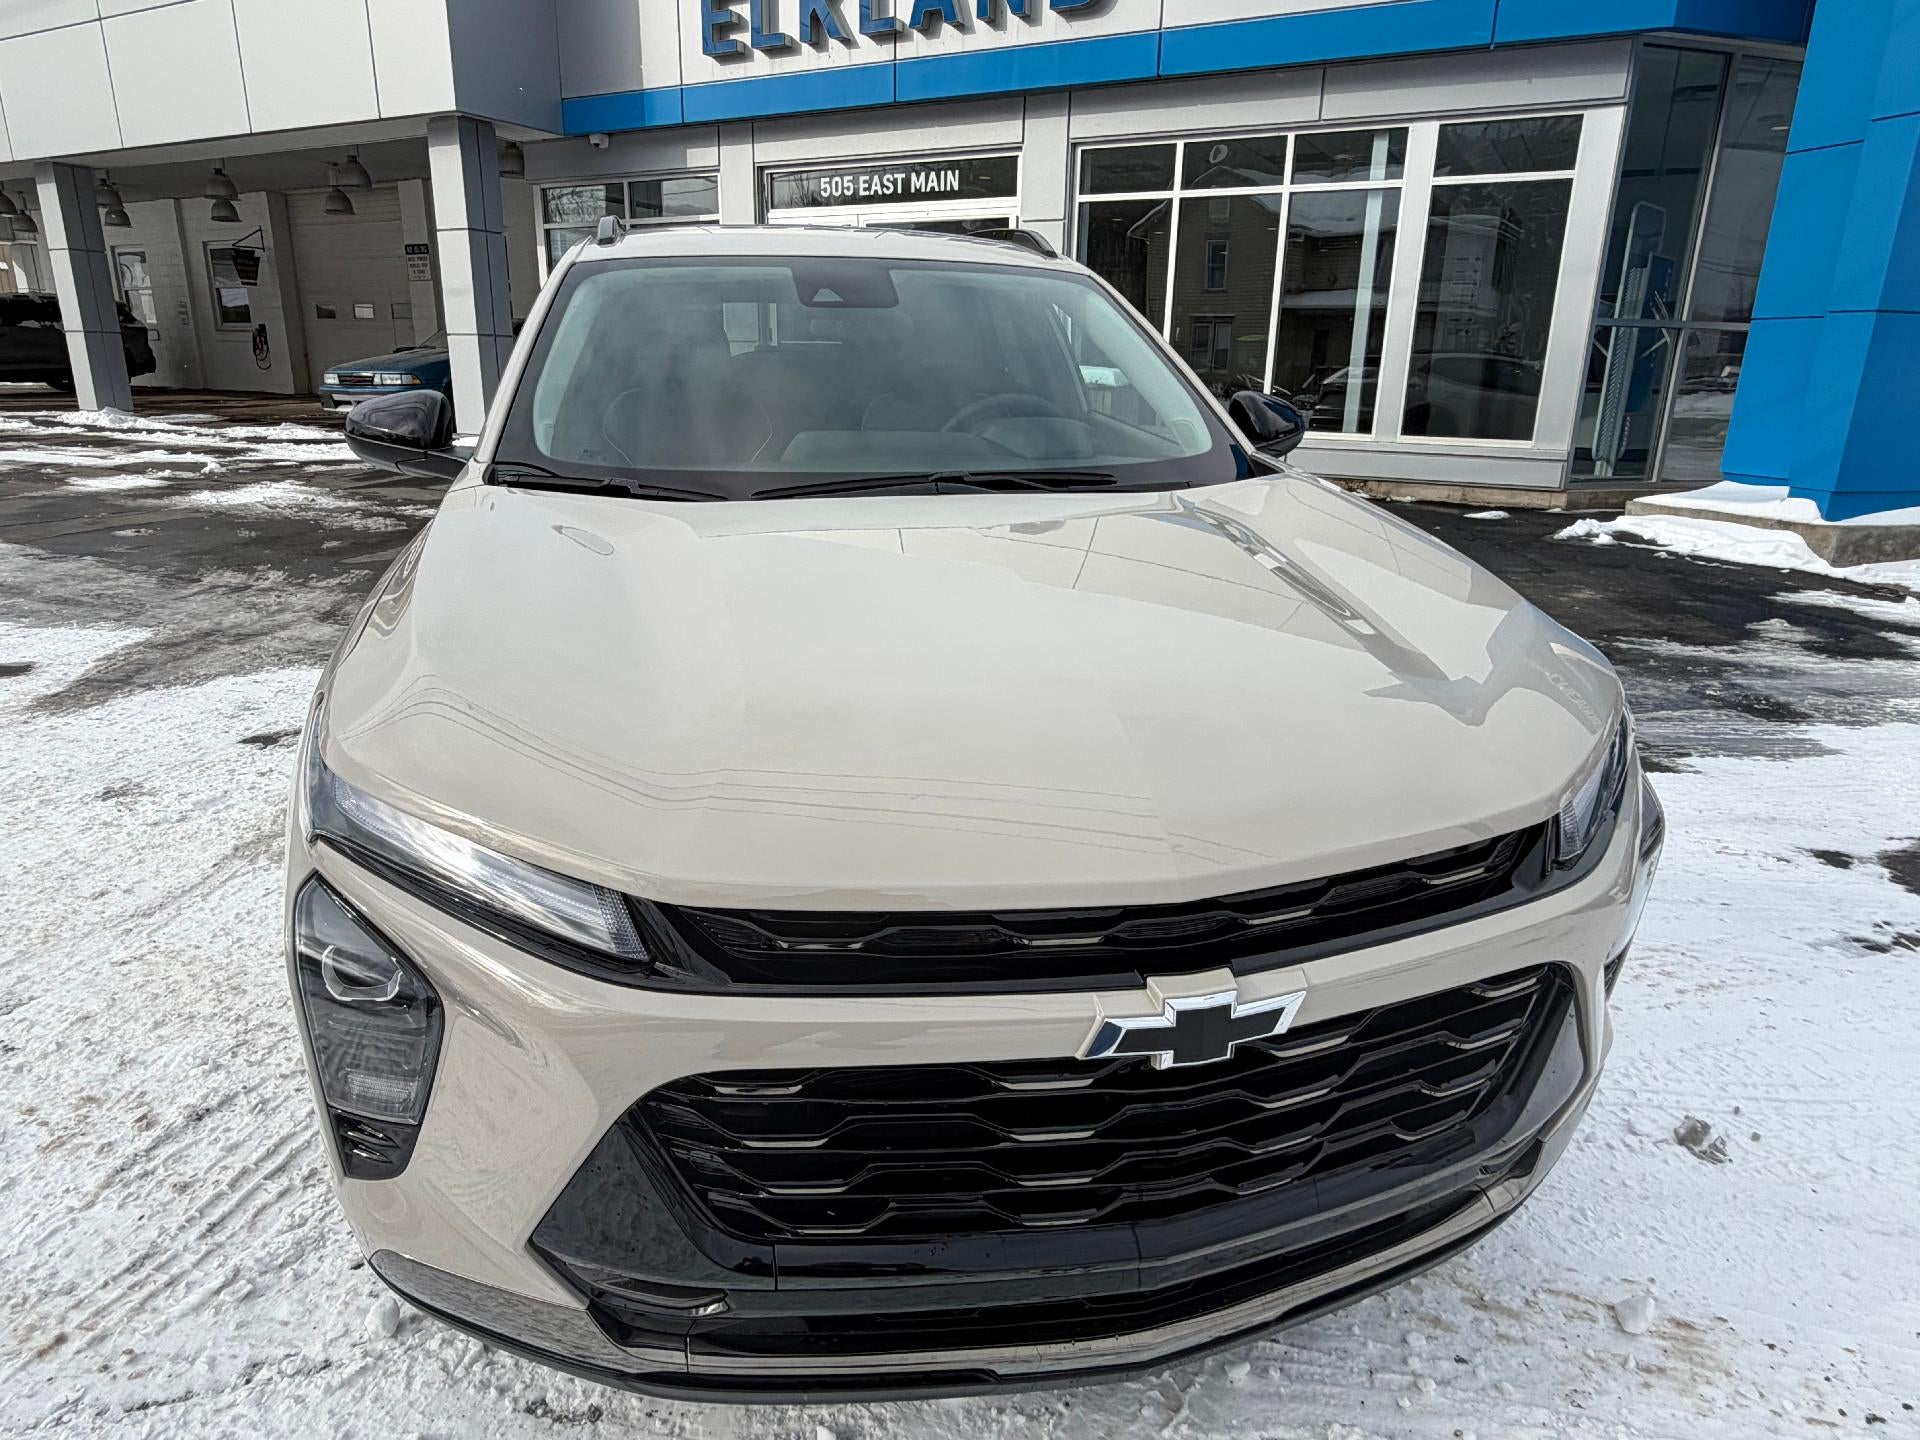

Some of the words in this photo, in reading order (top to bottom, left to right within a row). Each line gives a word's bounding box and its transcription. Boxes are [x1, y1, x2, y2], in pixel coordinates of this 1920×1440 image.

[701, 0, 1098, 56] ELKL
[820, 175, 854, 198] 505
[859, 173, 906, 196] EAST
[910, 169, 960, 193] MAIN
